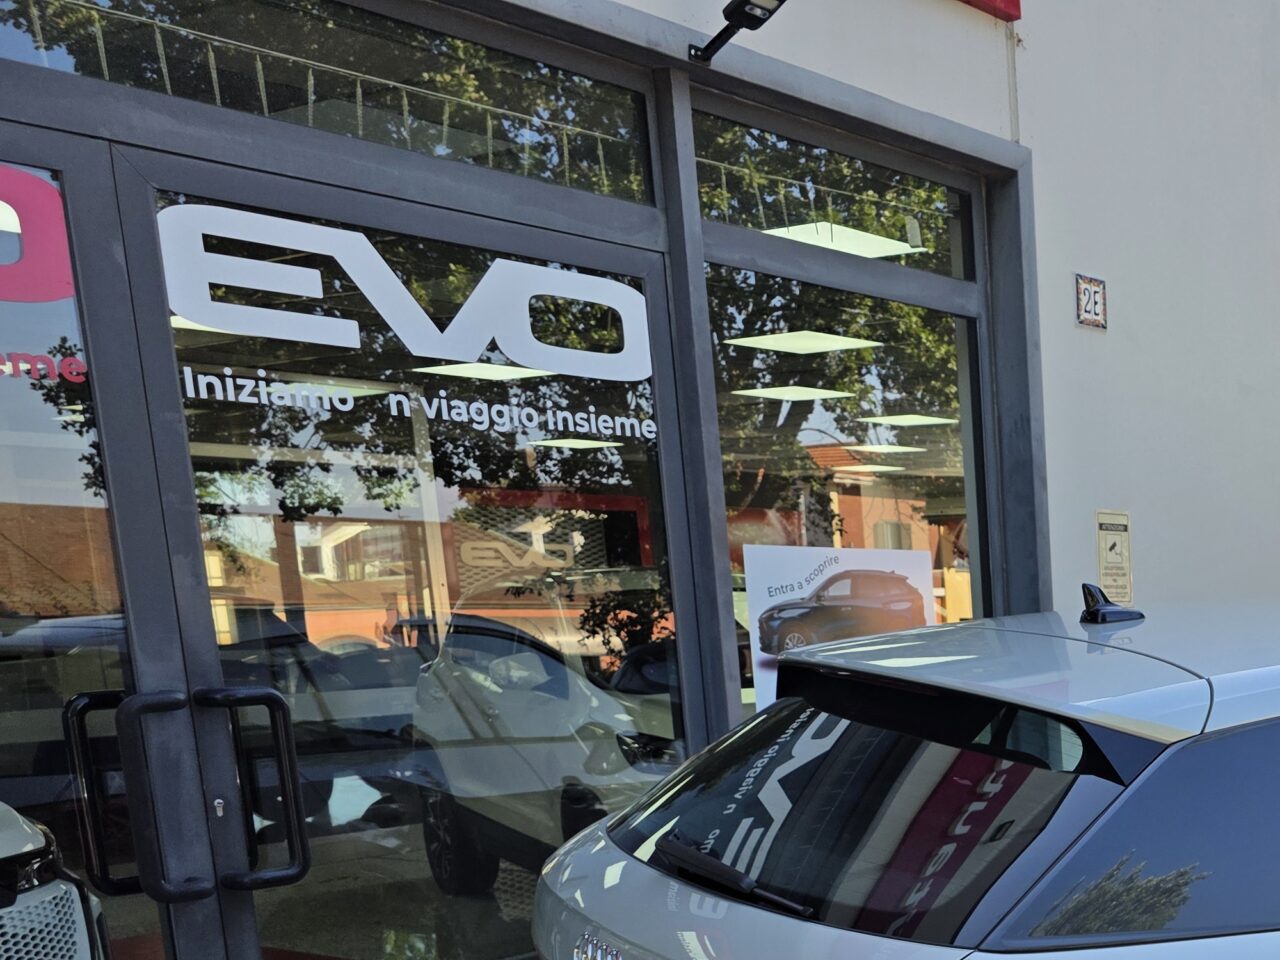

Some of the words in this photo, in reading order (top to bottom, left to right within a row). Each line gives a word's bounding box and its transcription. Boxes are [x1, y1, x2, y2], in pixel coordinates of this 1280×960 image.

[156, 203, 654, 382] EVO
[1083, 287, 1100, 316] 2E
[182, 366, 355, 412] Iniziamo
[418, 389, 540, 432] viaggio
[545, 400, 658, 439] insieme
[460, 540, 575, 568] EVO
[767, 583, 795, 598] Entra
[797, 581, 804, 590] a
[804, 555, 840, 586] scoprire
